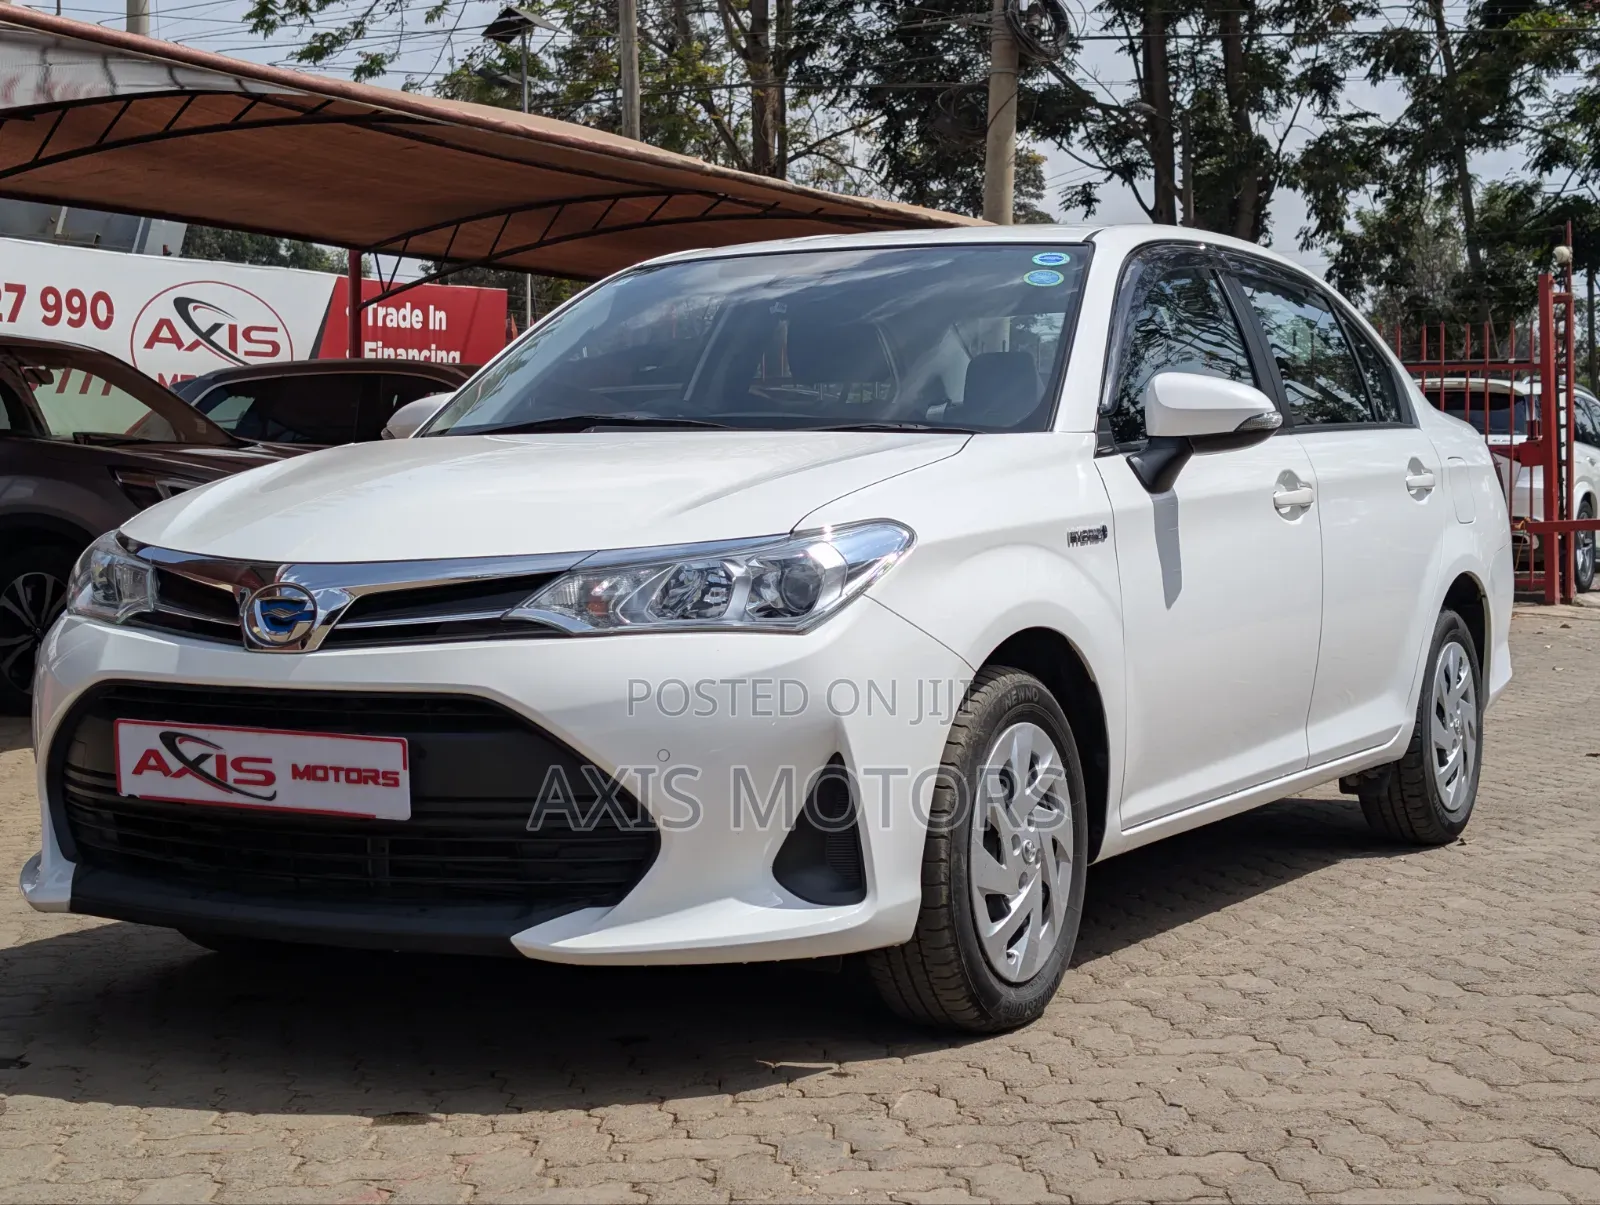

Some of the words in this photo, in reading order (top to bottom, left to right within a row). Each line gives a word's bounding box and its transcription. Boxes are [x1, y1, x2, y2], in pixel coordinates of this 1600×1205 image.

[0, 283, 27, 323] 7
[40, 286, 115, 330] 990
[143, 299, 281, 361] AXIS
[364, 301, 424, 330] Trade
[429, 305, 447, 330] In
[131, 736, 277, 797] AXIS
[291, 763, 400, 788] MOTORS
